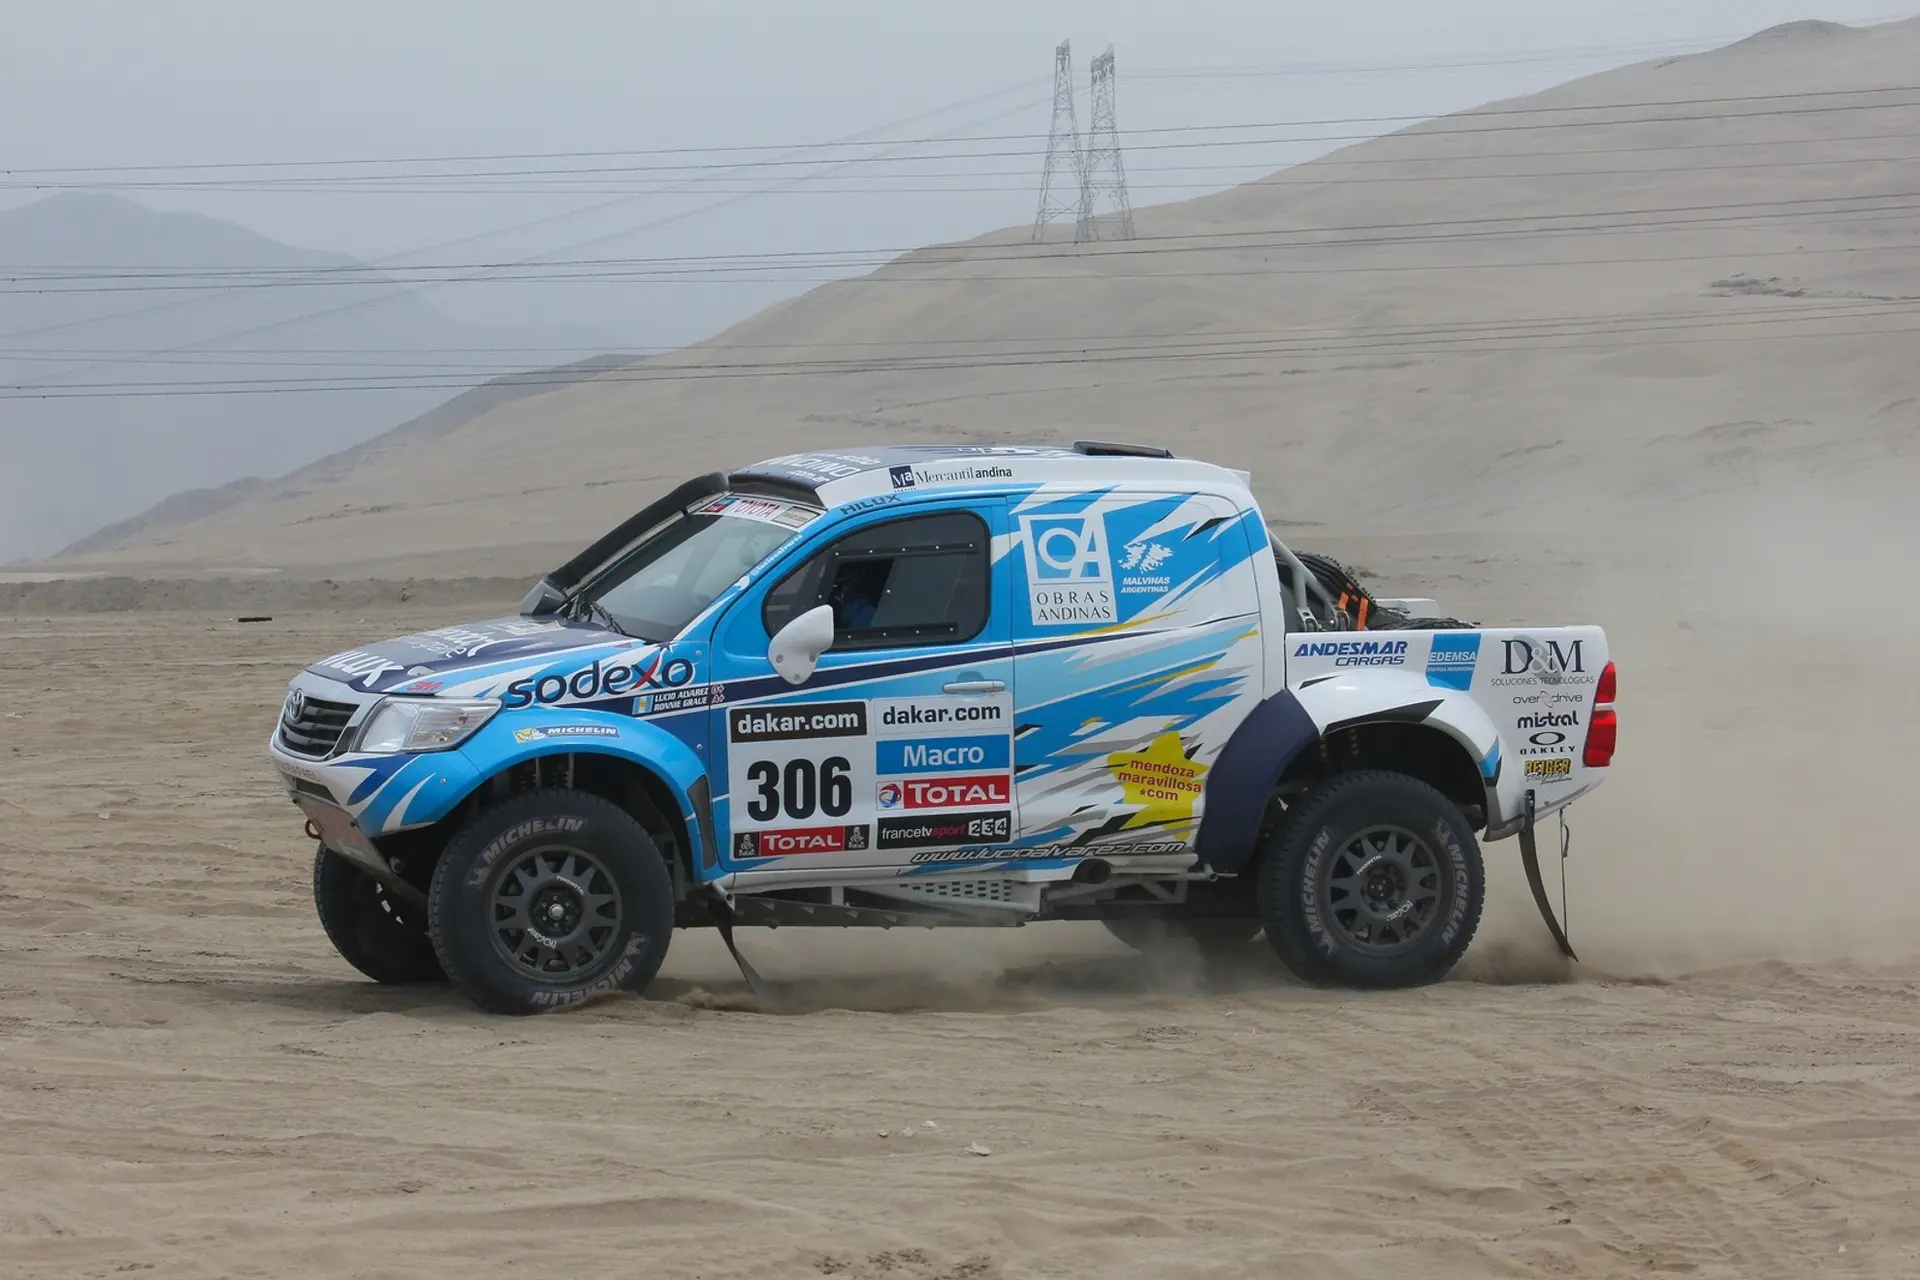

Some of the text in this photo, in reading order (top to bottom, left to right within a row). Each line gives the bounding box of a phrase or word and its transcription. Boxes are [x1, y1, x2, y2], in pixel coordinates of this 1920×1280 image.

[731, 499, 781, 518] TOYOTA
[840, 494, 901, 515] HILUX
[1120, 585, 1169, 594] ARGENTINAS
[1122, 576, 1170, 585] MALVINAS
[1036, 590, 1109, 605] OBRAS
[1037, 606, 1111, 621] ANDINAS
[1294, 641, 1408, 657] ANDESMAR
[1429, 651, 1477, 662] EDEMSA
[1335, 655, 1405, 667] CARGAS
[506, 656, 693, 709] sodexo
[1491, 677, 1538, 686] SOLUCIONES
[677, 687, 710, 699] ALVAREZ
[738, 713, 858, 734] dakar.com
[883, 705, 1001, 725] dakar.com
[1517, 710, 1579, 729] mistral
[547, 726, 617, 736] MICHELIN
[903, 744, 985, 767] Macro
[1520, 745, 1576, 755] OAKLEY
[1130, 760, 1195, 778] mendoza
[747, 756, 852, 822] 306
[1118, 771, 1202, 793] maravillosa
[907, 783, 1006, 805] TOTAL
[483, 817, 583, 865] MICHELIN
[763, 834, 841, 851] TOTAL
[911, 841, 1187, 864] www.lucioalvarez.com
[1303, 829, 1330, 932] MICHELIN
[1442, 844, 1467, 946] MICHELIN
